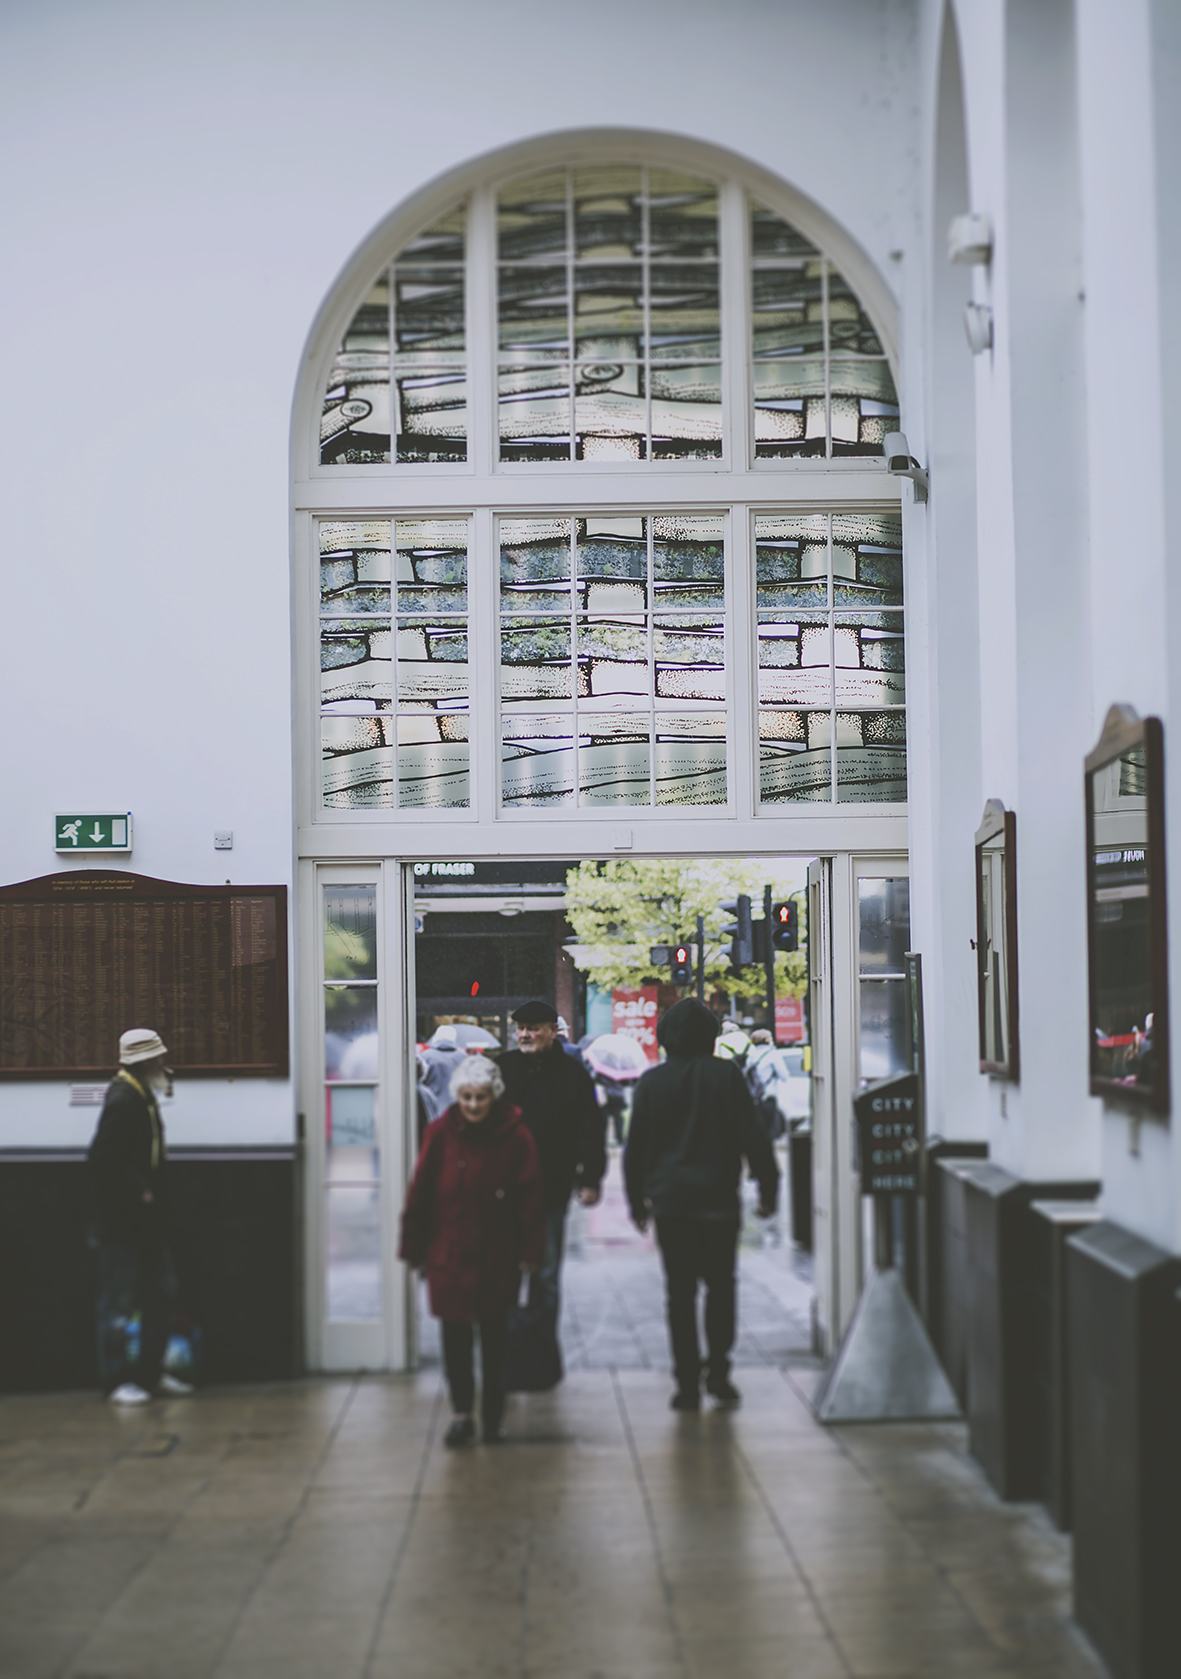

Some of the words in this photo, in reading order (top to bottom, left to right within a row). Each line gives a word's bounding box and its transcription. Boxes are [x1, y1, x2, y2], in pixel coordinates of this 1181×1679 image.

[414, 863, 430, 876] OF
[431, 863, 475, 876] FRASER
[613, 997, 657, 1018] sale
[871, 1098, 914, 1112] CITY
[871, 1123, 915, 1138] CITY
